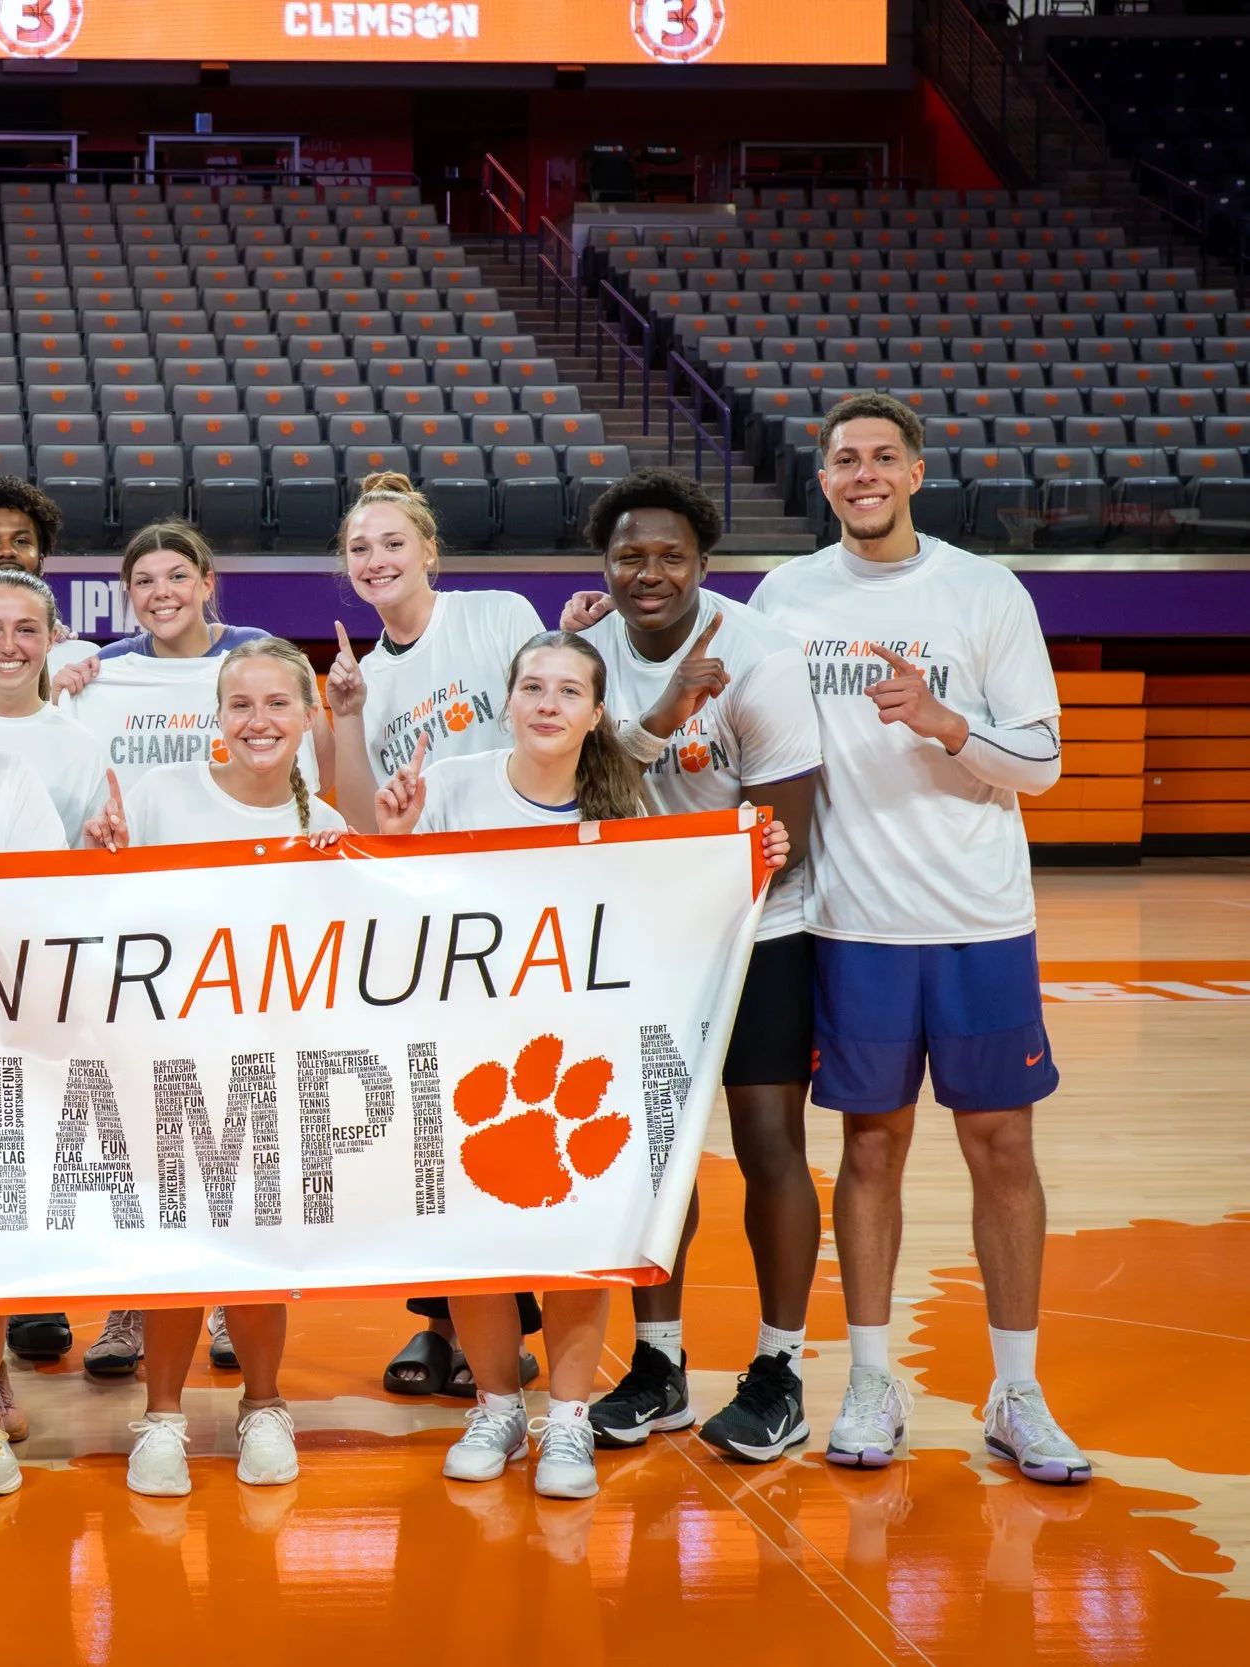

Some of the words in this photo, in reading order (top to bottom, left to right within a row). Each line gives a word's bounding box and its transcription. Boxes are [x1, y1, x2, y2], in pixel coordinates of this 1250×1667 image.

[640, 1025, 667, 1034] EFFORT
[641, 1033, 671, 1041] TEAMWORK
[407, 1042, 437, 1051] COMPETE
[641, 1040, 674, 1048] BATTLESHIP
[296, 1050, 327, 1060] TENNIS
[328, 1049, 369, 1058] SPORTSMANSHIP
[408, 1050, 437, 1058] KICKBALL
[641, 1047, 679, 1055] RACQUETBALL
[70, 1059, 105, 1068] COMPETE
[232, 1052, 275, 1066] COMPETE
[343, 1055, 380, 1067] FRISBEE
[297, 1059, 342, 1069] VOLLEYBALL
[408, 1058, 438, 1073] FLAG
[642, 1061, 686, 1069] DETERMINATION
[69, 1067, 109, 1078] KICKBALL
[154, 1065, 196, 1074] BATTLESHIP
[232, 1064, 276, 1077] KICKBALL
[298, 1069, 314, 1077] FLAG
[316, 1066, 347, 1076] FOOTBALL
[348, 1065, 388, 1073] DETERMINATION
[642, 1067, 689, 1079] SPIKEBALL
[2, 1068, 14, 1089] FUN
[154, 1073, 198, 1083] TEAMWORK
[230, 1075, 276, 1084] SPORTSMANSHIP
[410, 1071, 439, 1079] FOOTBALL
[154, 1082, 202, 1091] RACQUETBALL
[298, 1082, 329, 1091] EFFORT
[362, 1078, 393, 1086] BATTLESHIP
[411, 1079, 441, 1087] BATTLESHIP
[643, 1080, 659, 1089] FUN
[67, 1083, 113, 1091] SPORTSMANSHIP
[228, 1081, 277, 1093] VOLLEYBALL
[411, 1086, 441, 1094] SPIKEBALL
[15, 1066, 24, 1128] SPORTSMANSHIP
[251, 1091, 277, 1103] FLAG
[366, 1091, 395, 1101] EFFORT
[184, 1097, 205, 1108] FUN
[299, 1099, 330, 1108] TENNIS
[366, 1100, 395, 1108] SPIKEBALL
[412, 1101, 442, 1109] SOFTBALL
[4, 1090, 13, 1127] SOCCER
[93, 1104, 118, 1112] TENNIS
[186, 1107, 208, 1115] TENNIS
[366, 1107, 395, 1117] TENNIS
[413, 1108, 442, 1117] SOCCER
[659, 1080, 675, 1143] VOLLEYBALL
[62, 1109, 88, 1120] PLAY
[225, 1117, 247, 1128] PLAY
[300, 1115, 331, 1124] FRISBEE
[414, 1116, 443, 1126] TENNIS
[156, 1123, 183, 1135] PLAY
[252, 1121, 278, 1130] EFFORT
[301, 1124, 331, 1133] EFFORT
[654, 1115, 663, 1144] SOCCER
[191, 1127, 212, 1136] FLAG
[332, 1124, 387, 1140] RESPECT
[414, 1125, 443, 1136] EFFORT
[253, 1134, 279, 1144] TENNIS
[301, 1134, 332, 1142] SOCCER
[57, 1143, 84, 1151] EFFORT
[102, 1140, 127, 1154] FUN
[301, 1142, 331, 1150] FRISBEE
[414, 1142, 444, 1150] RESPECT
[56, 1152, 82, 1163] FLAG
[253, 1152, 280, 1164] FLAG
[414, 1150, 444, 1159] FRISBEE
[54, 1163, 88, 1171] FOOTBALL
[89, 1162, 131, 1171] TEAMWORK
[302, 1162, 333, 1171] COMPETE
[414, 1159, 432, 1168] PLAY
[201, 1167, 238, 1175] SOFTBALL
[53, 1172, 112, 1184] BATTLESHIP
[114, 1172, 133, 1182] FUN
[416, 1168, 424, 1188] POLO
[52, 1184, 110, 1192] DETERMINATION
[111, 1183, 135, 1194] PLAY
[158, 1159, 167, 1210] DETERMINATION
[167, 1159, 178, 1210] SPIKEBALL
[178, 1159, 186, 1209] SPORTSMANSHIP
[205, 1183, 235, 1192] EFFORT
[302, 1176, 334, 1194] FUN
[426, 1167, 436, 1215] TEAMWORK
[437, 1166, 446, 1214] RACQUETBALL
[19, 1184, 27, 1215] SOCCER
[303, 1194, 333, 1202] SOFTBALL
[304, 1201, 334, 1209] KICKBALL
[416, 1190, 425, 1216] WATER
[160, 1211, 187, 1223] FLAG
[304, 1208, 334, 1217] EFFORT
[46, 1217, 75, 1230] PLAY
[115, 1220, 145, 1229] TENNIS
[213, 1219, 229, 1228] FUN
[304, 1216, 334, 1225] FRISBEE
